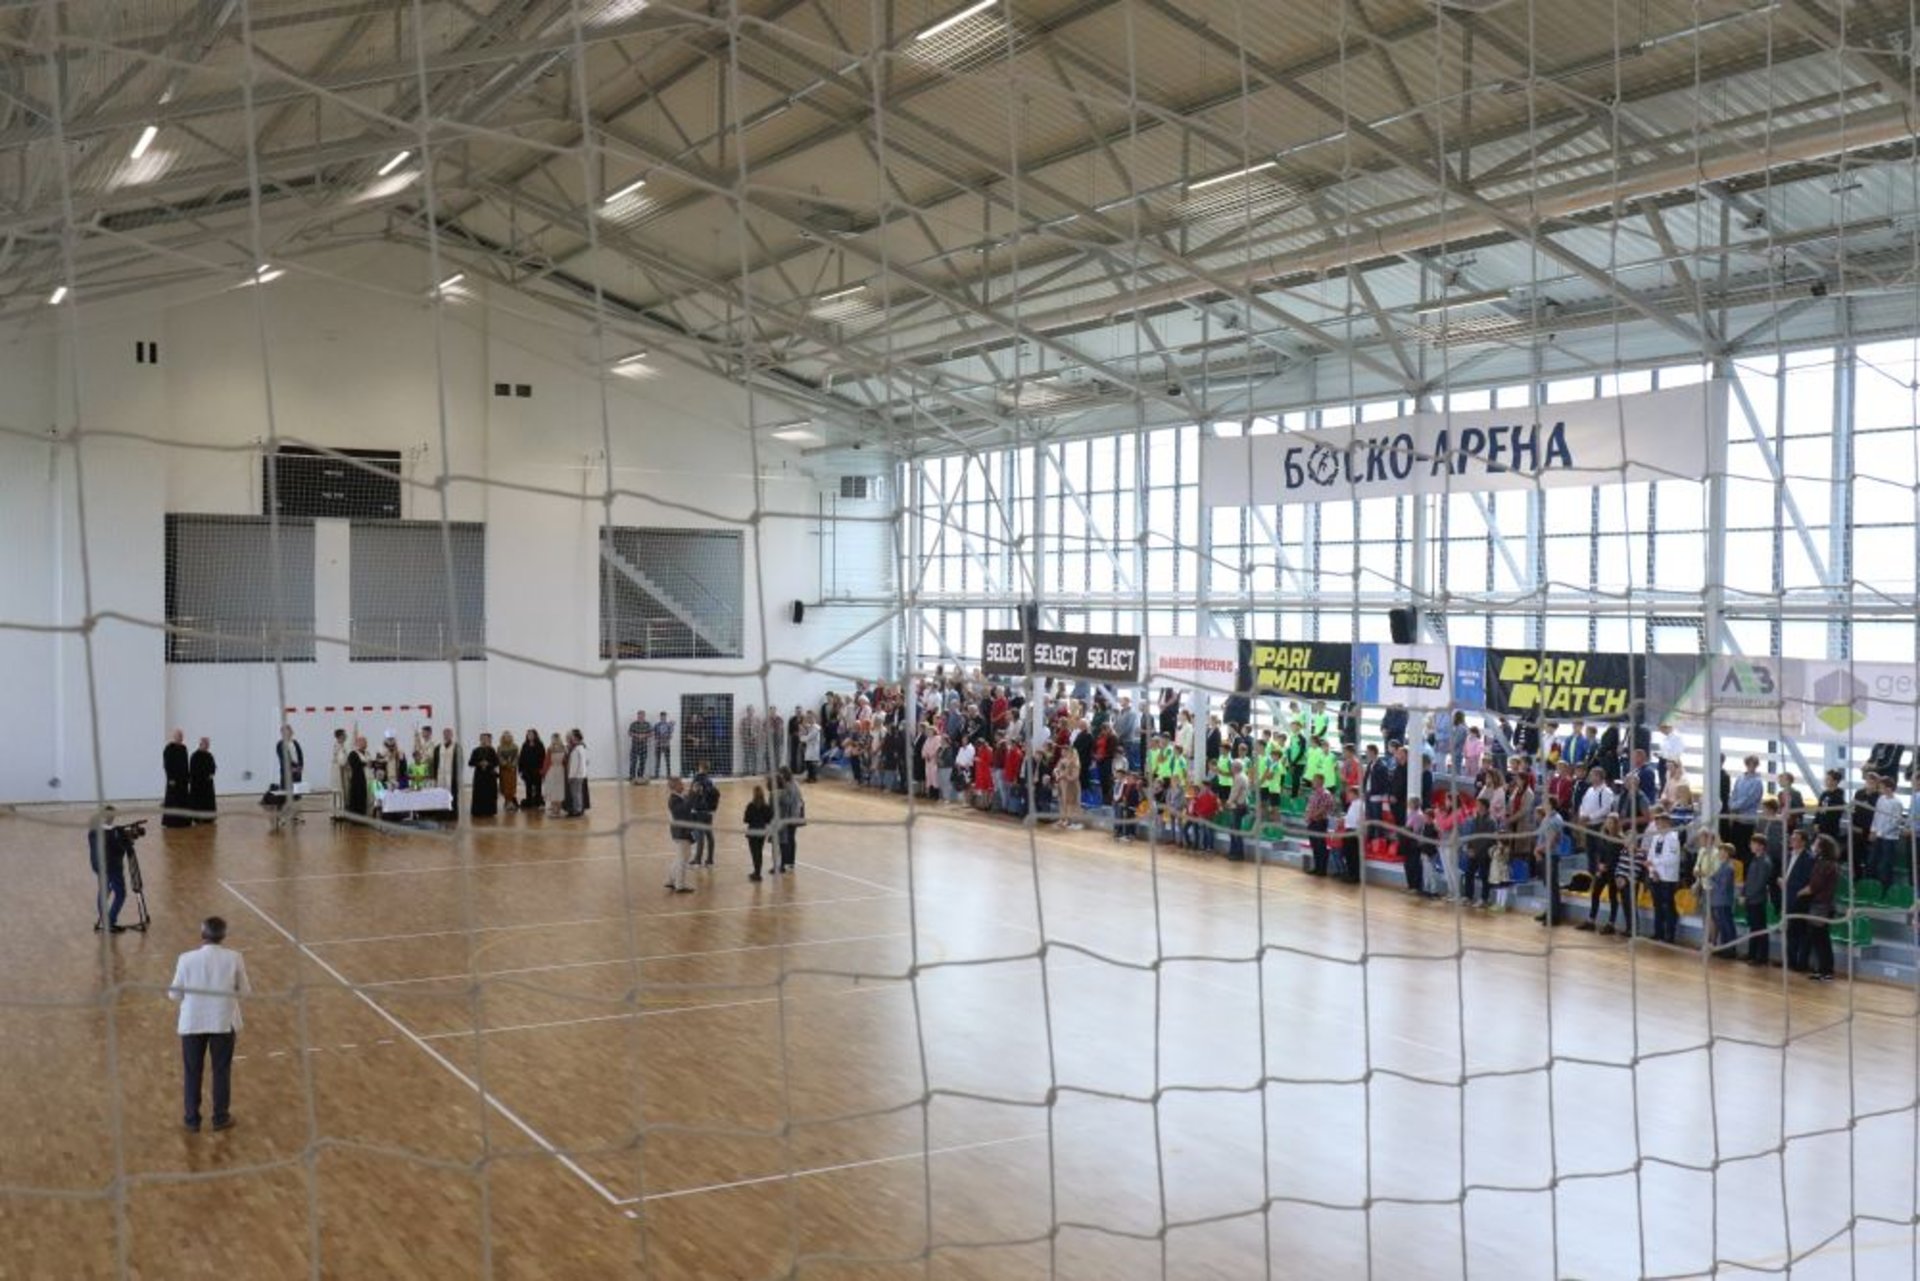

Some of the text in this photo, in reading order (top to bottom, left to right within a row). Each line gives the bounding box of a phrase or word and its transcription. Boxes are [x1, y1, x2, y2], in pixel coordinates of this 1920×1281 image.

[986, 642, 1026, 663] SELECT
[1034, 643, 1077, 666] SELECT
[1086, 648, 1136, 671] SELECT
[1255, 646, 1311, 668] PARI
[1499, 656, 1587, 685] PARI
[1259, 669, 1340, 694] MATCH
[1508, 683, 1627, 713] MATCH
